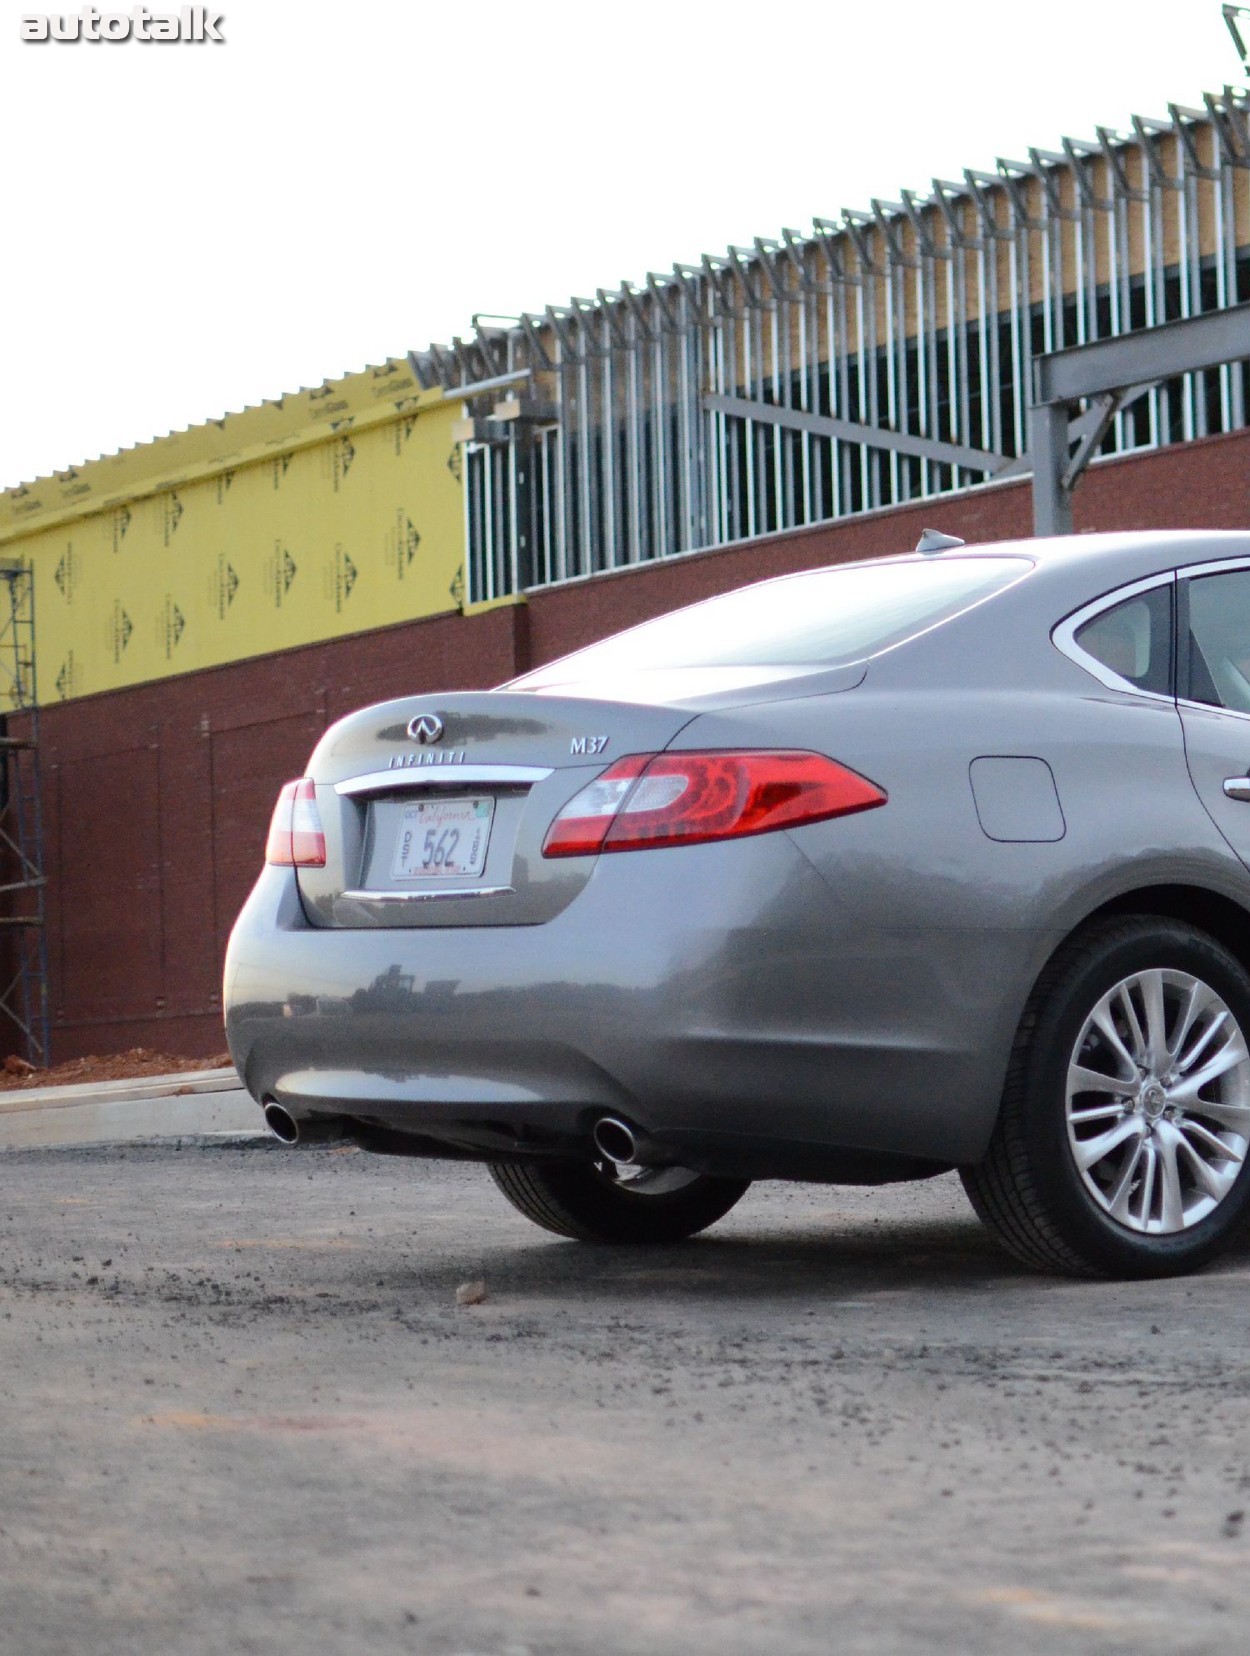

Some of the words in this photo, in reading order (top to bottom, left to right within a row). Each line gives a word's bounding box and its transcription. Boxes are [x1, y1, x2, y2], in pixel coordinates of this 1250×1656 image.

[570, 735, 610, 755] M37
[388, 751, 466, 768] INFINITI
[418, 804, 476, 829] California
[421, 828, 460, 868] 562
